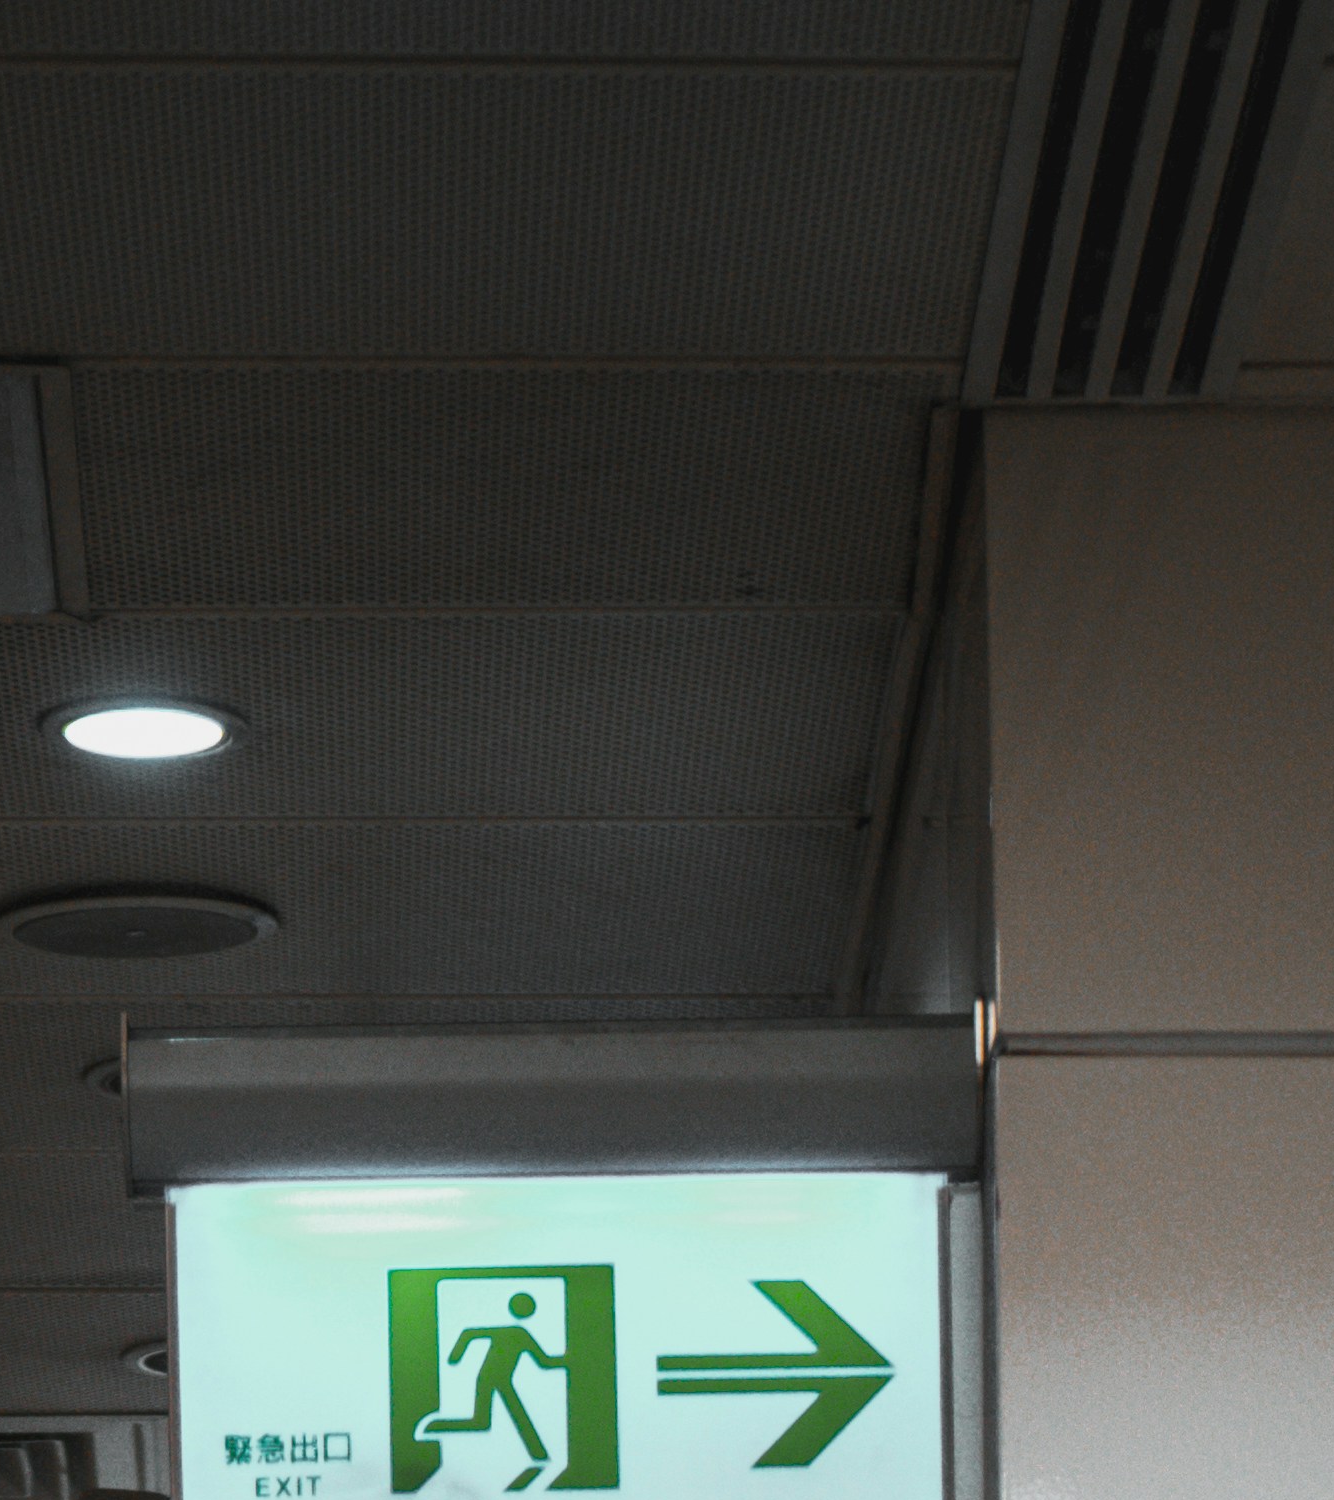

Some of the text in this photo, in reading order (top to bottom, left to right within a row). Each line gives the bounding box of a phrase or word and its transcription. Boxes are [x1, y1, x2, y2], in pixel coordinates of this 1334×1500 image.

[224, 1432, 352, 1465] 緊急出口
[254, 1474, 322, 1498] EXIT
